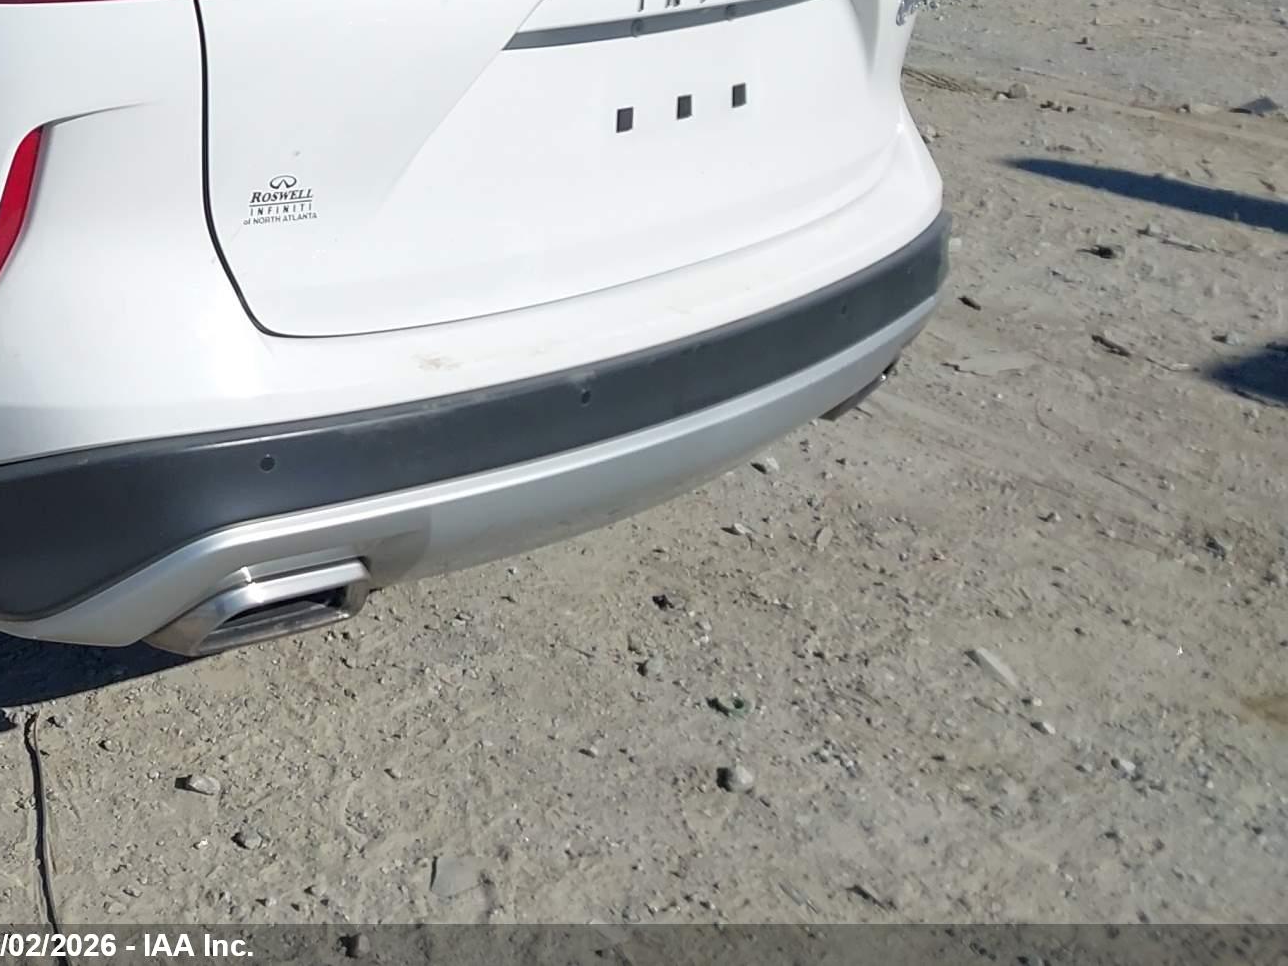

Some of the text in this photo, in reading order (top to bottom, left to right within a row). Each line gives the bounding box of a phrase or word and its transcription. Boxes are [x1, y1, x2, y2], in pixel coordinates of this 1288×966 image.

[250, 202, 312, 216] INFINITI
[253, 215, 281, 225] NORTH
[282, 212, 318, 223] ATLANTA
